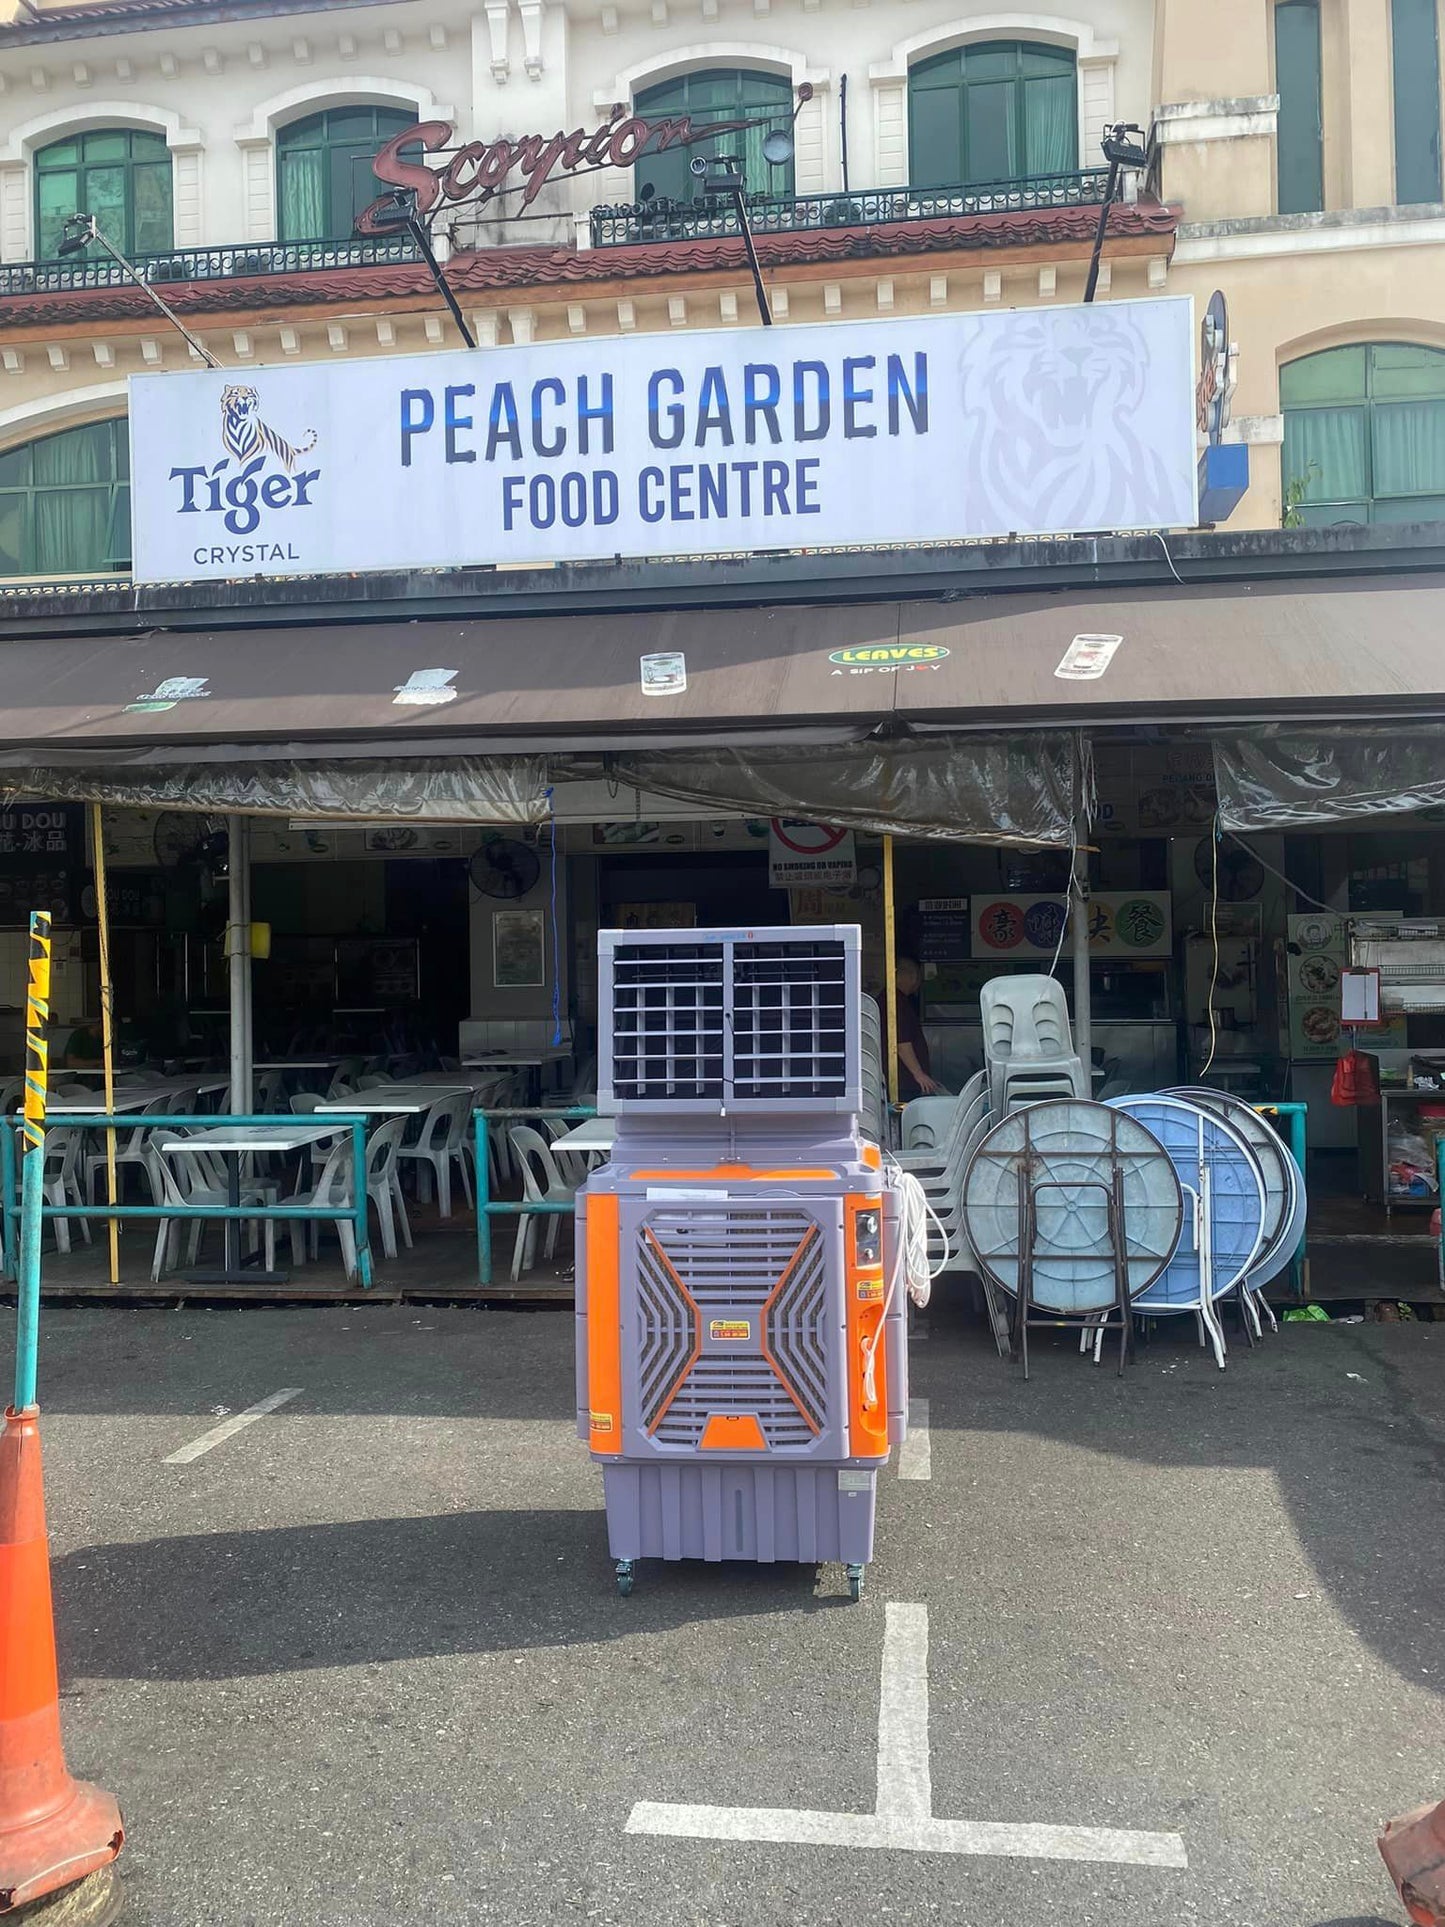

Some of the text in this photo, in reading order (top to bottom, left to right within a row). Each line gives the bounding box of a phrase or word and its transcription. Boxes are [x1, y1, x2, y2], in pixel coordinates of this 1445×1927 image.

[354, 101, 770, 235] Scorpion
[400, 350, 929, 467] PEACH GARDEN
[168, 455, 321, 536] Tiger
[502, 457, 822, 531] FOOD CENTRE
[193, 541, 301, 566] CRYSTAL
[841, 647, 939, 662] LEAVES
[849, 667, 874, 675] SIP
[21, 812, 67, 829] DOU
[772, 863, 783, 871] NO
